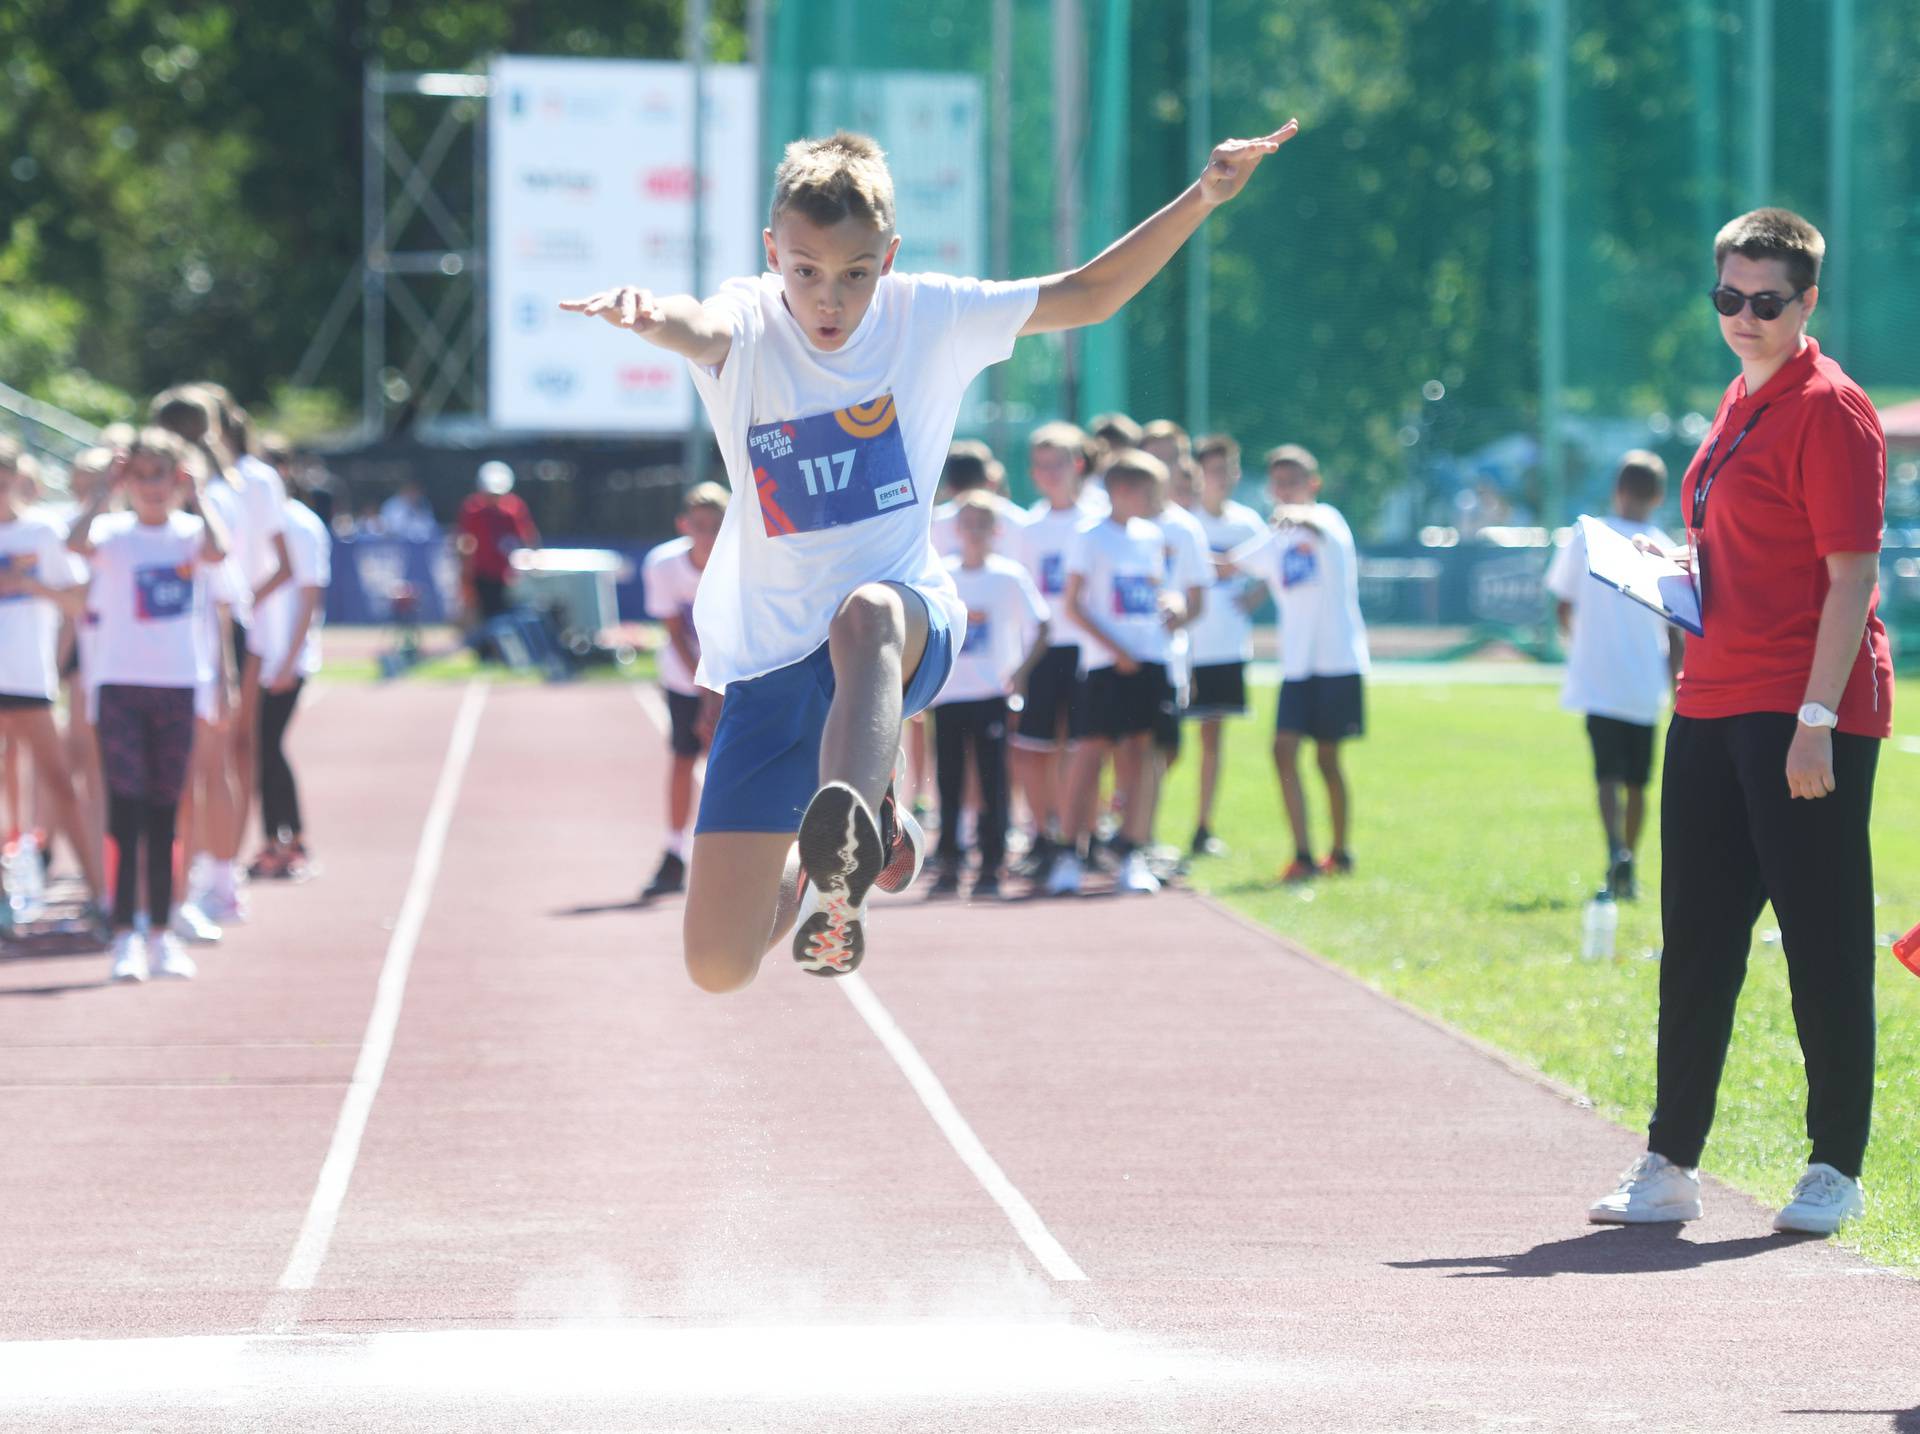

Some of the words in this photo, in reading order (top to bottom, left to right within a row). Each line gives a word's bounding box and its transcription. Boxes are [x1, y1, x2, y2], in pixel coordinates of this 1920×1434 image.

[750, 429, 781, 447] ERSTE
[760, 435, 791, 453] PLAVA
[771, 445, 793, 460] LIGA
[798, 448, 857, 496] 117
[880, 488, 900, 501] ERSTE
